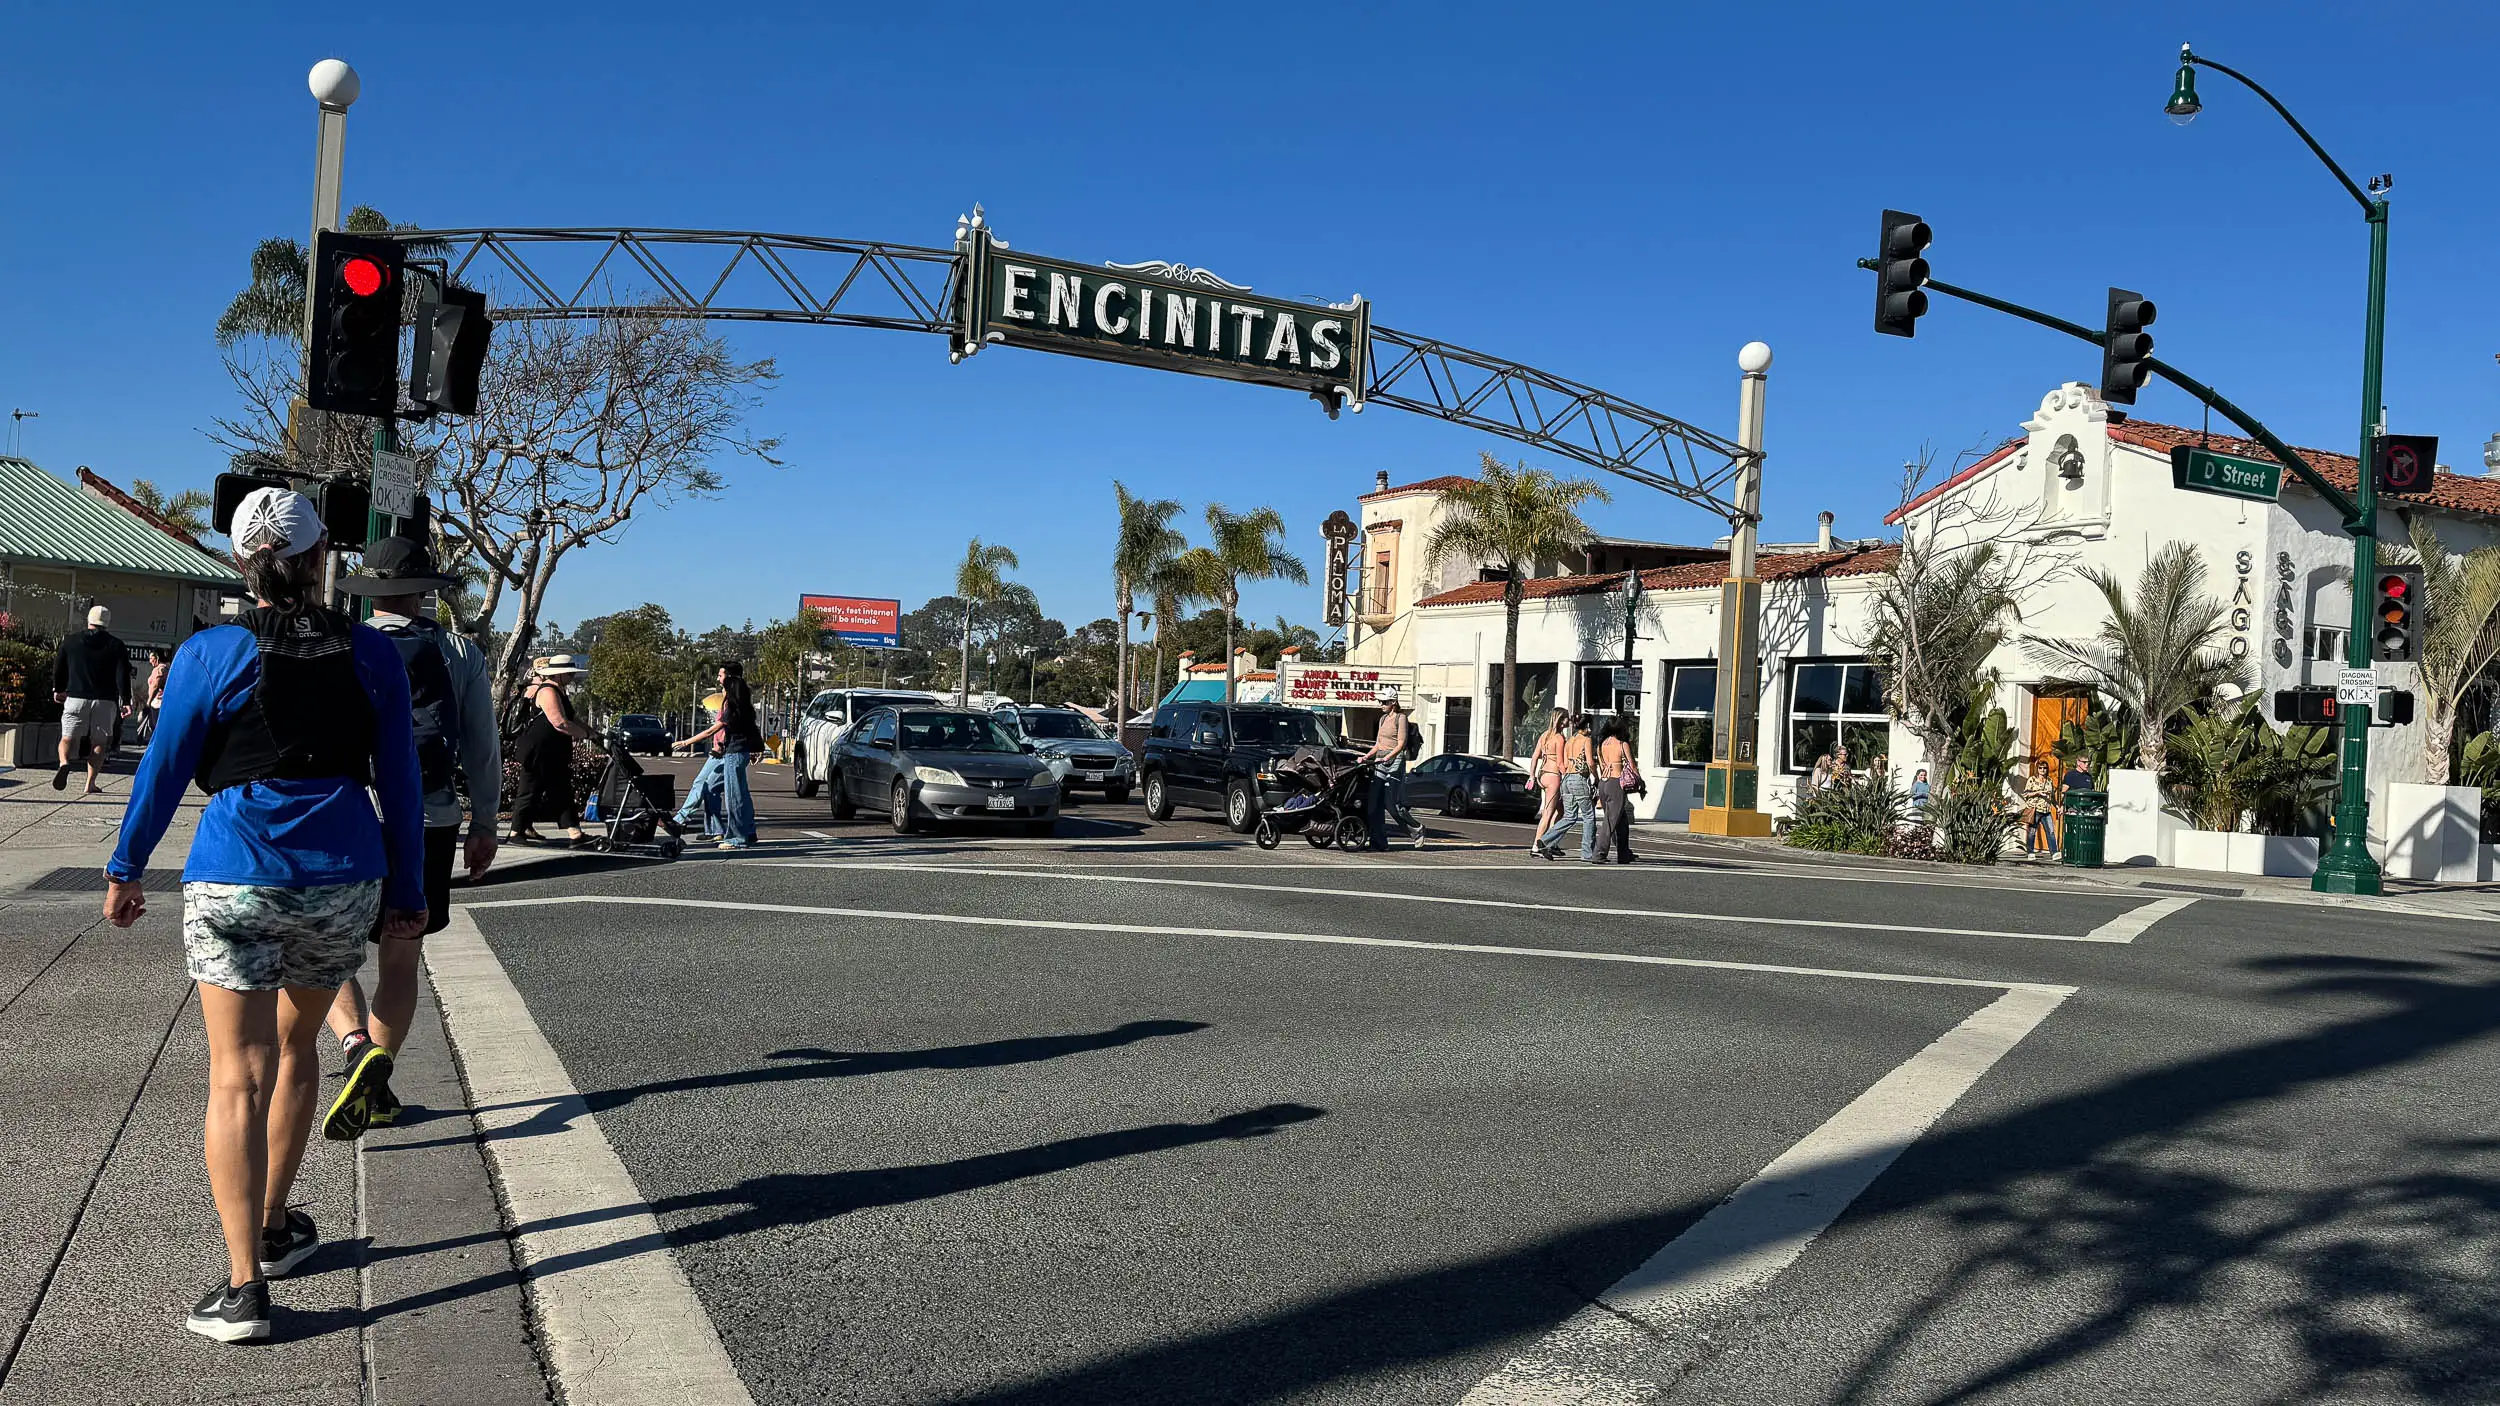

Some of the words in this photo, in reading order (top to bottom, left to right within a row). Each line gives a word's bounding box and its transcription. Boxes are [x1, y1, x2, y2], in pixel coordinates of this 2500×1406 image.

[1003, 264, 1342, 369] ENCINITAS
[380, 458, 412, 474] DIAGONAL
[379, 470, 411, 486] CROSSING
[2204, 461, 2216, 479] D
[2222, 464, 2266, 489] Street
[376, 486, 392, 508] OK
[1333, 525, 1347, 534] LA
[1331, 536, 1346, 617] PALOMA
[2229, 551, 2252, 659] SAGO
[863, 607, 894, 617] internet
[149, 620, 167, 633] 476
[884, 636, 896, 646] ting
[1350, 671, 1380, 682] FLOW
[2341, 672, 2374, 680] DIAGONAL
[1294, 679, 1328, 690] BANFF
[1354, 682, 1375, 691] FILM
[1291, 689, 1327, 700] OSCAR
[1335, 691, 1377, 702] SHORTS
[2339, 688, 2355, 700] OK
[2323, 698, 2335, 717] 10
